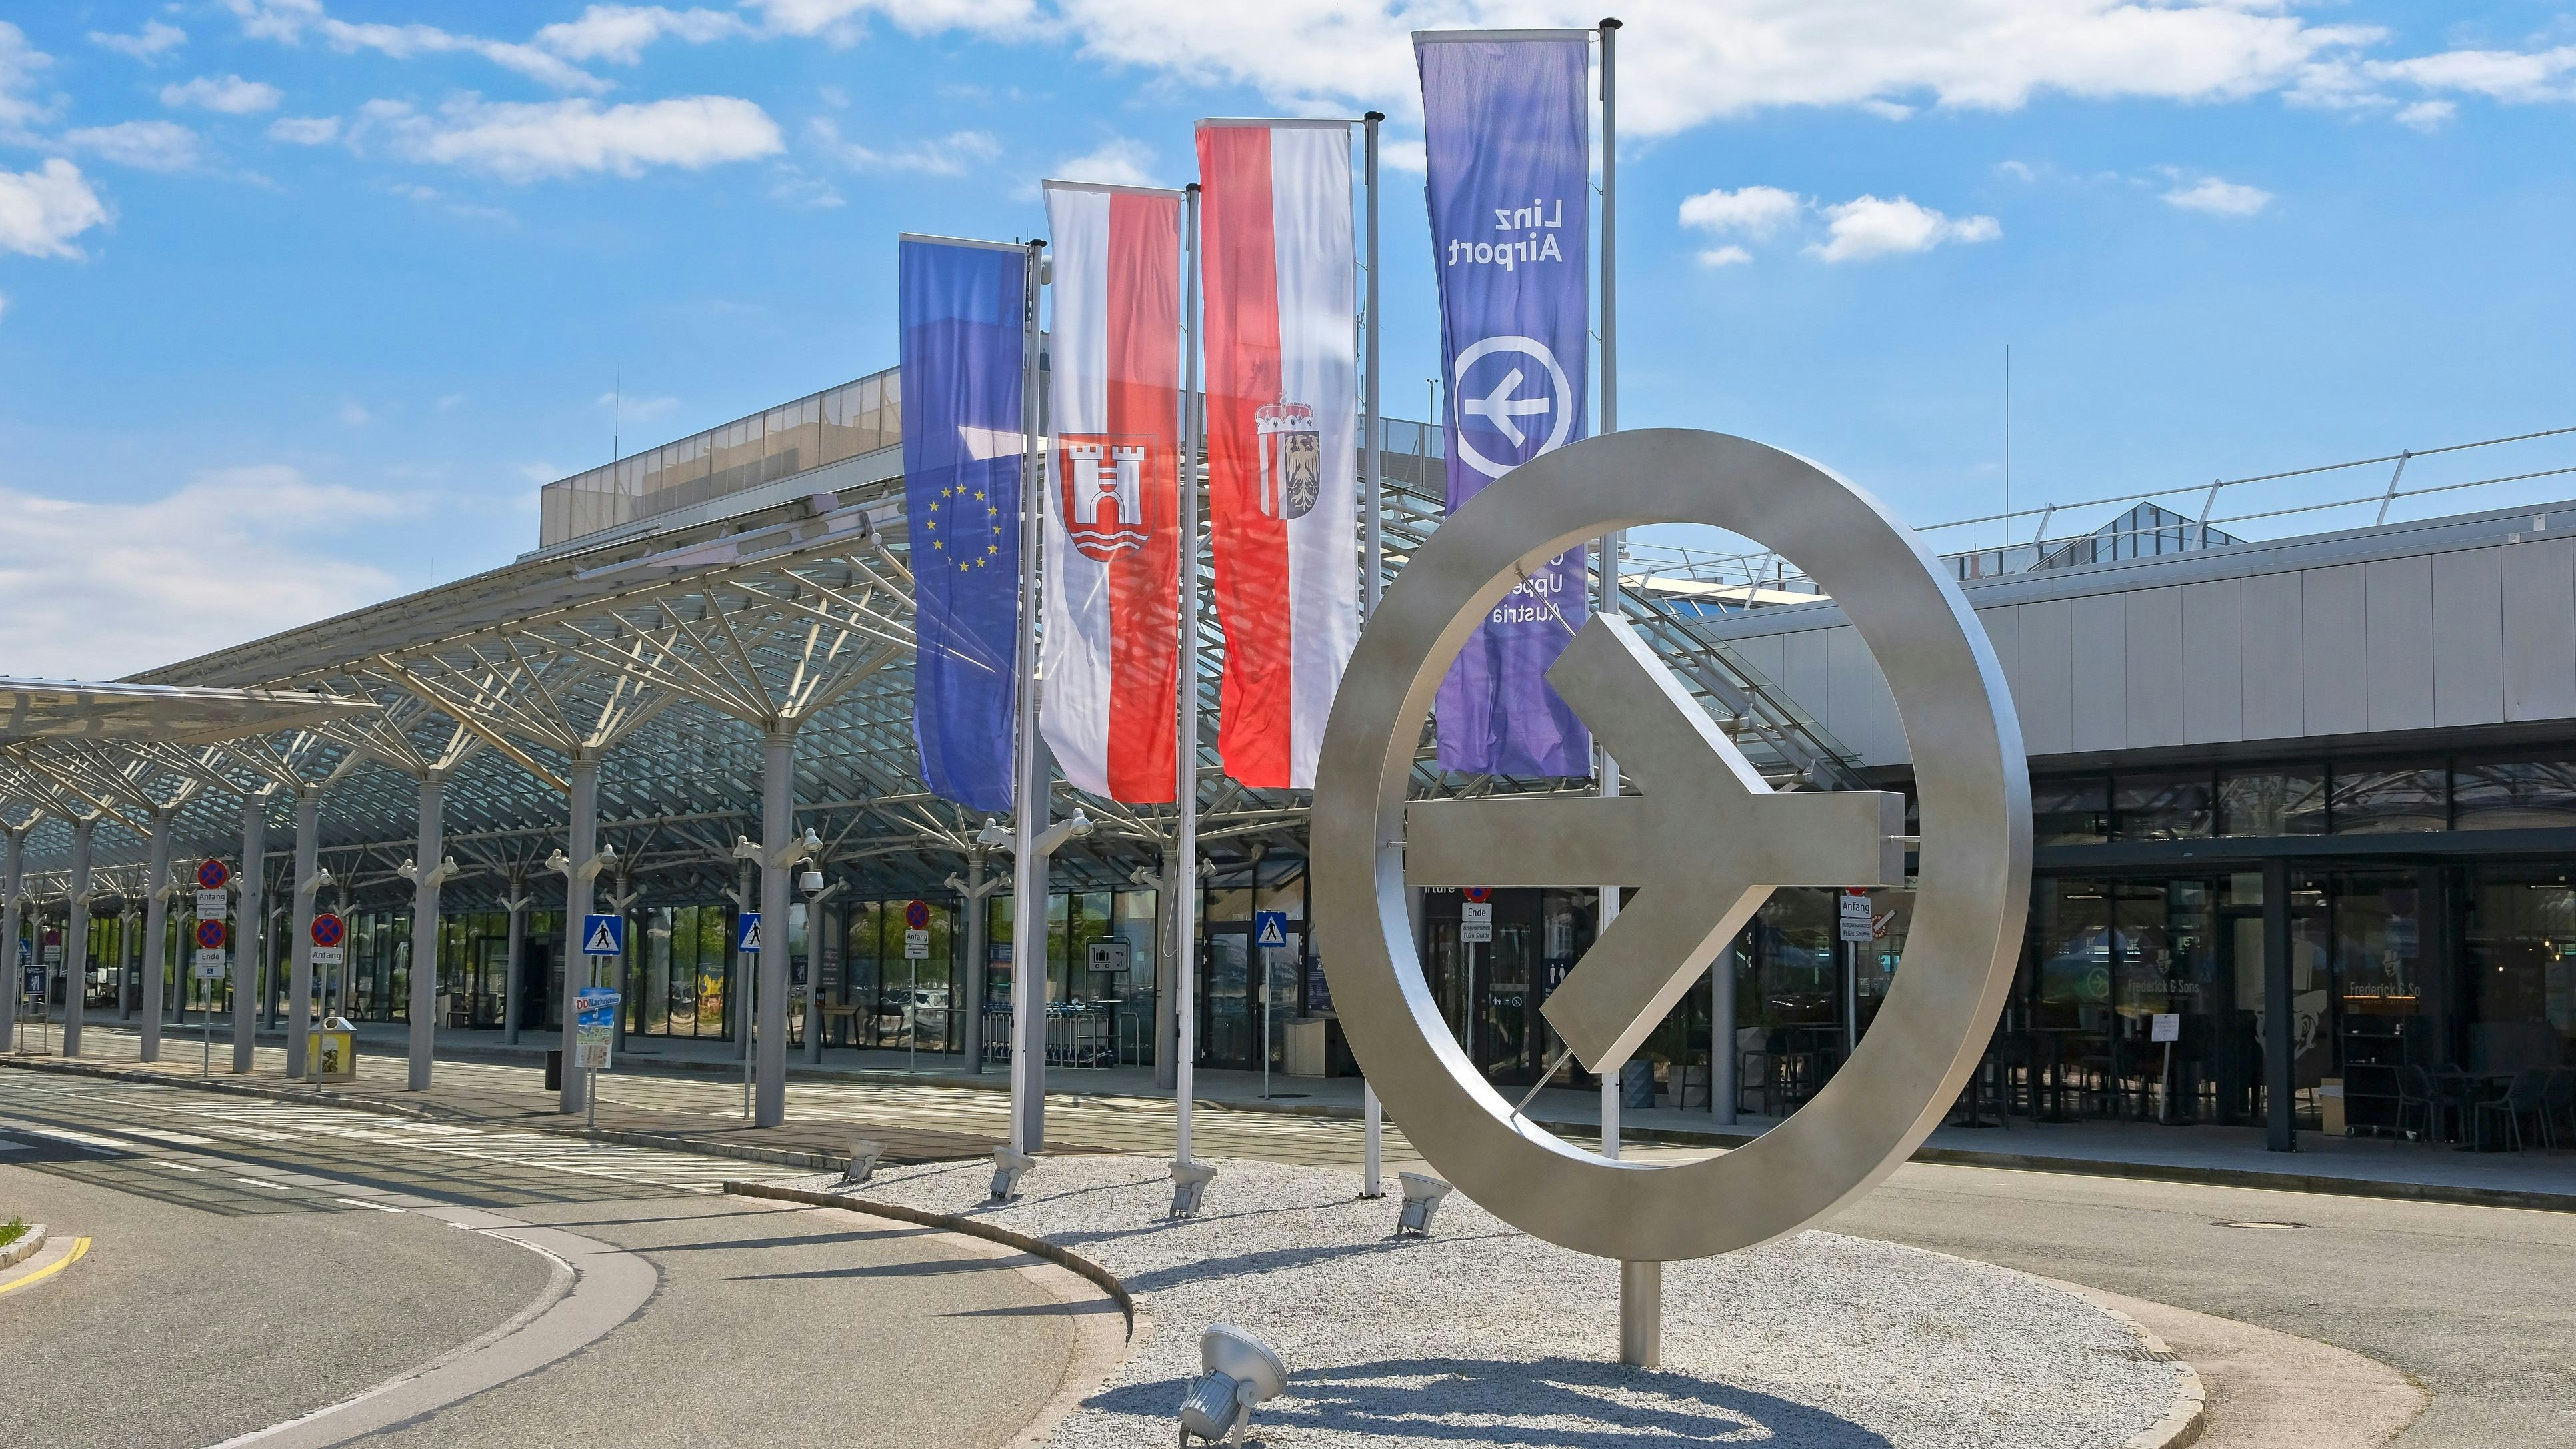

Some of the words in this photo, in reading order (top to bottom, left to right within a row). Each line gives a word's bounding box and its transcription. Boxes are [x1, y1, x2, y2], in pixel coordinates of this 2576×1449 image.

[1468, 908, 1486, 916] Ende
[1843, 901, 1869, 914] Anfang
[907, 934, 928, 942] Anfang
[313, 951, 341, 961] Anfang
[2128, 978, 2168, 992] Frederick
[2170, 979, 2177, 993] &
[2178, 979, 2200, 993] Sons
[2349, 982, 2395, 996] Frederick
[2398, 982, 2405, 996] &
[2408, 982, 2421, 997] So
